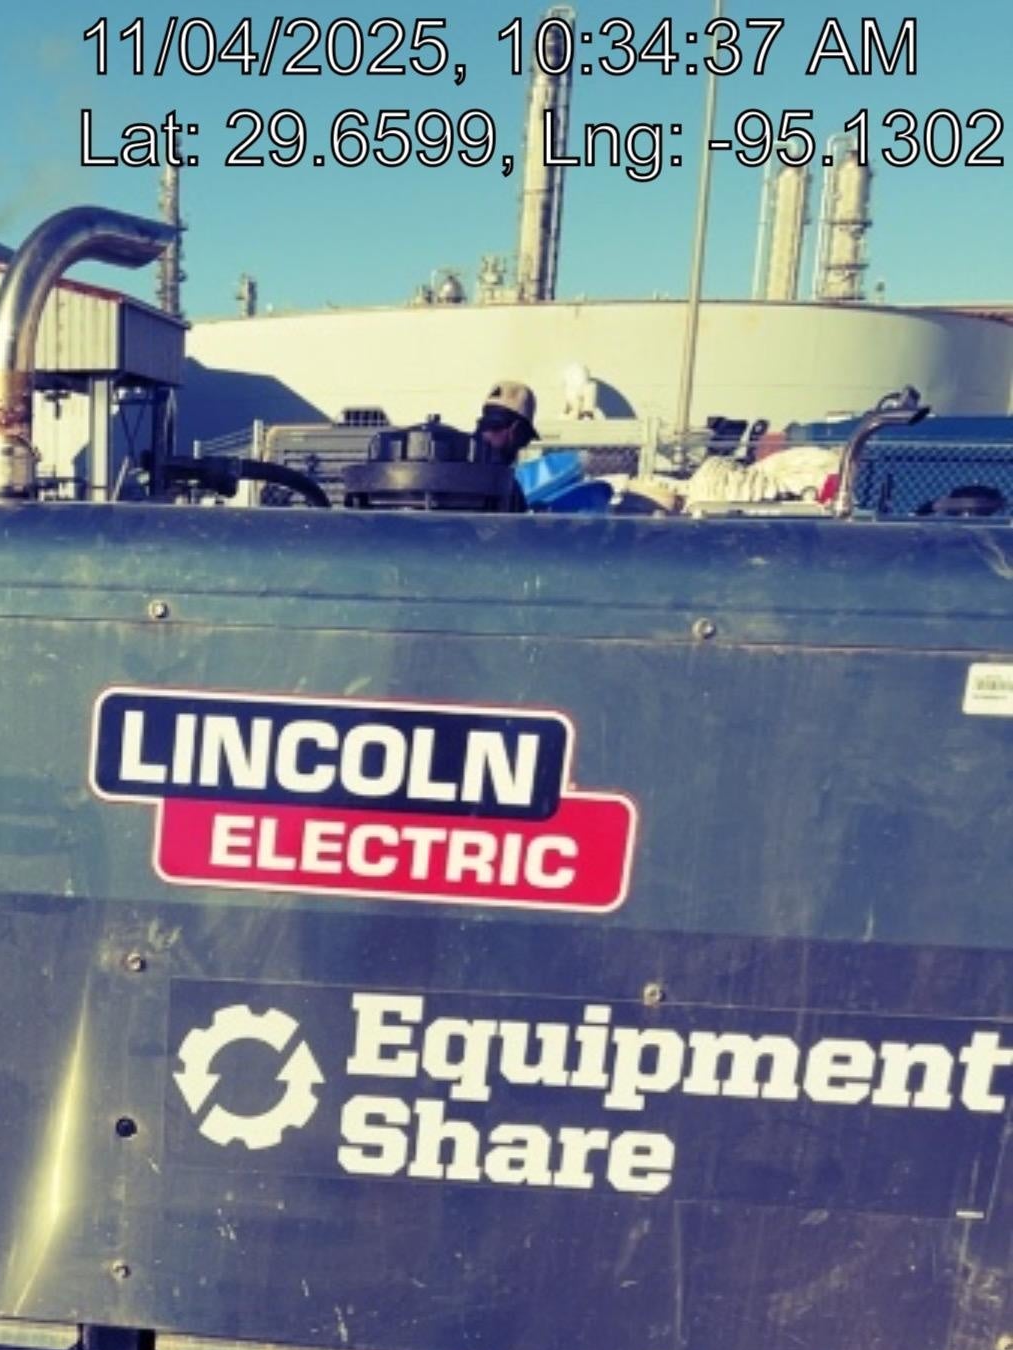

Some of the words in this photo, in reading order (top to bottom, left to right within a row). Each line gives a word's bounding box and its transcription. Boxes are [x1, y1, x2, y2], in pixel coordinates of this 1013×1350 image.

[118, 709, 540, 807] LINCOLN
[209, 814, 579, 890] ELECTRIC
[346, 992, 1013, 1114] Equipment
[337, 1093, 676, 1194] Share
